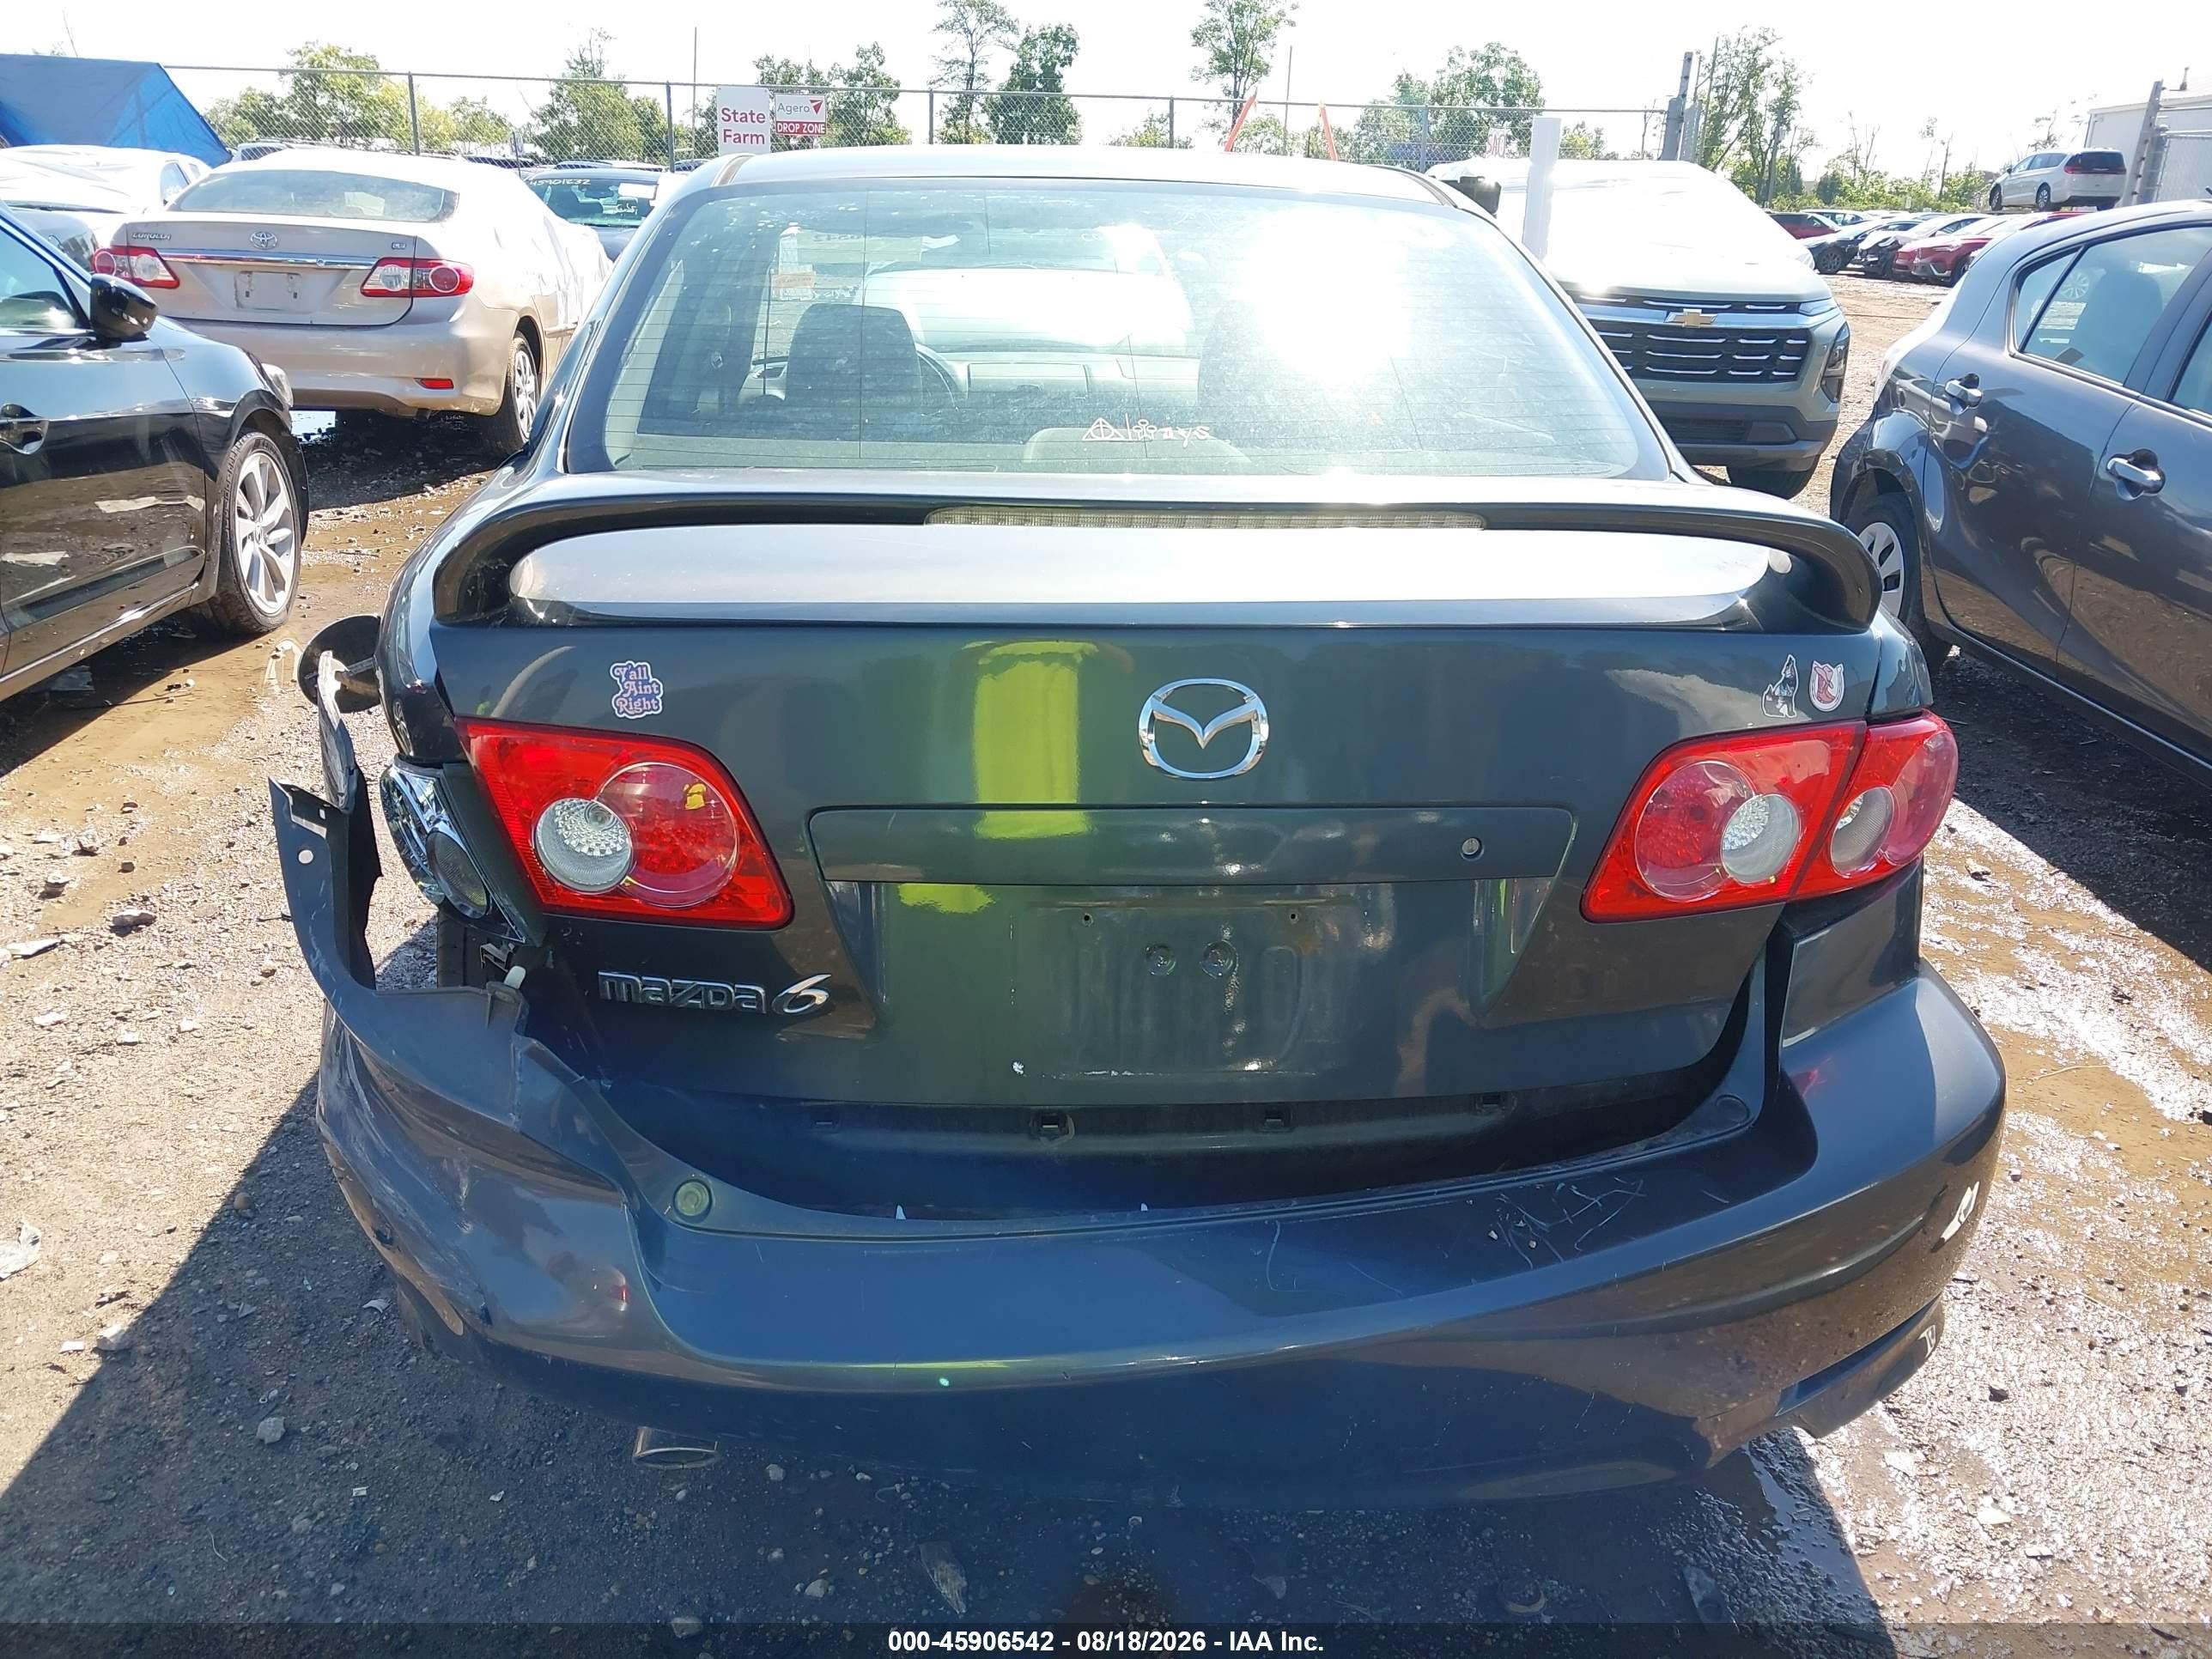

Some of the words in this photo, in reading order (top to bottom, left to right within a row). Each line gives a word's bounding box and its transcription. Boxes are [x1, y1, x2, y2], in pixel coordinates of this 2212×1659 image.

[721, 107, 766, 124] State
[777, 102, 811, 115] Agero
[722, 128, 766, 145] Farm
[776, 123, 800, 133] DROP
[802, 124, 825, 134] ZONE
[616, 697, 659, 714] Right
[771, 974, 832, 1015] 6
